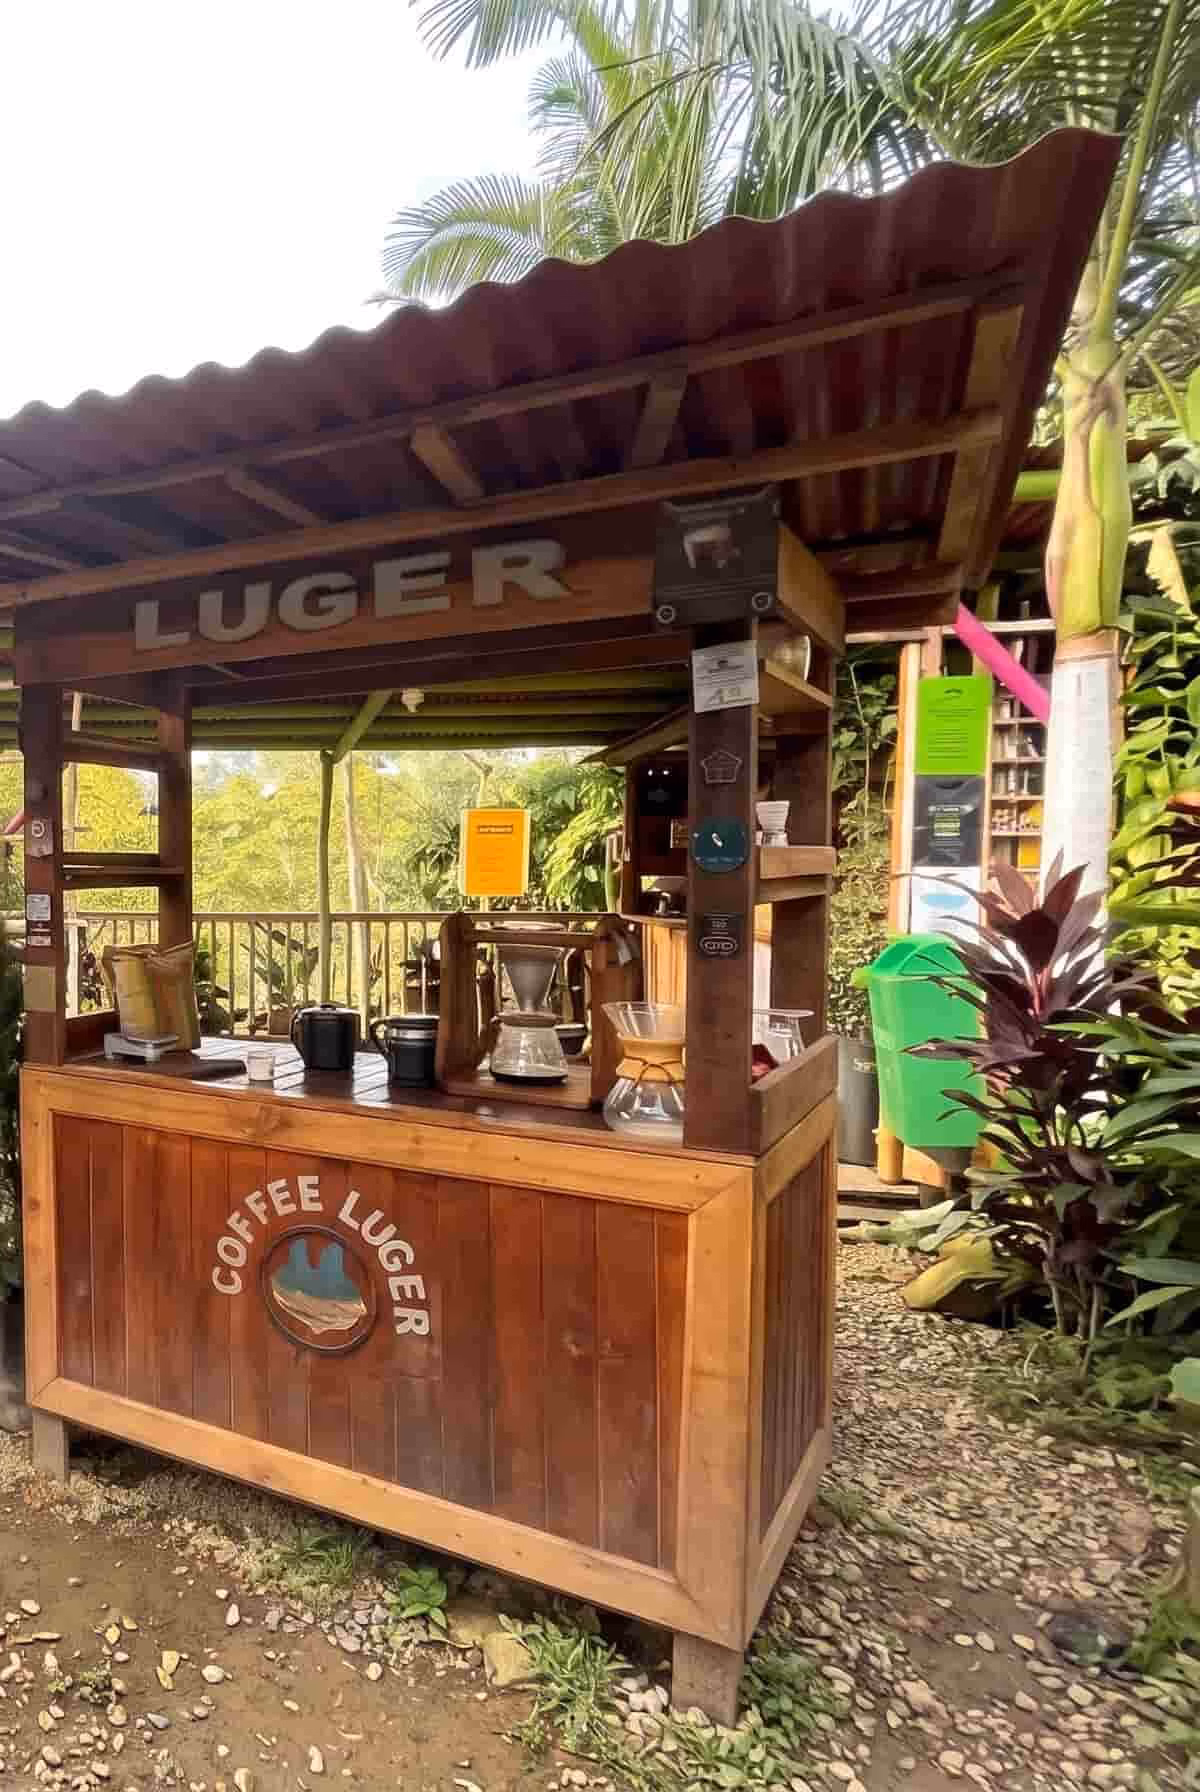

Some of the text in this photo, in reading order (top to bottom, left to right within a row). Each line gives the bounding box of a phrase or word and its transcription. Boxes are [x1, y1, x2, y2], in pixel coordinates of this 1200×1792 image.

[135, 539, 571, 650] LUGER
[212, 1175, 430, 1336] COFFEE LUGER
